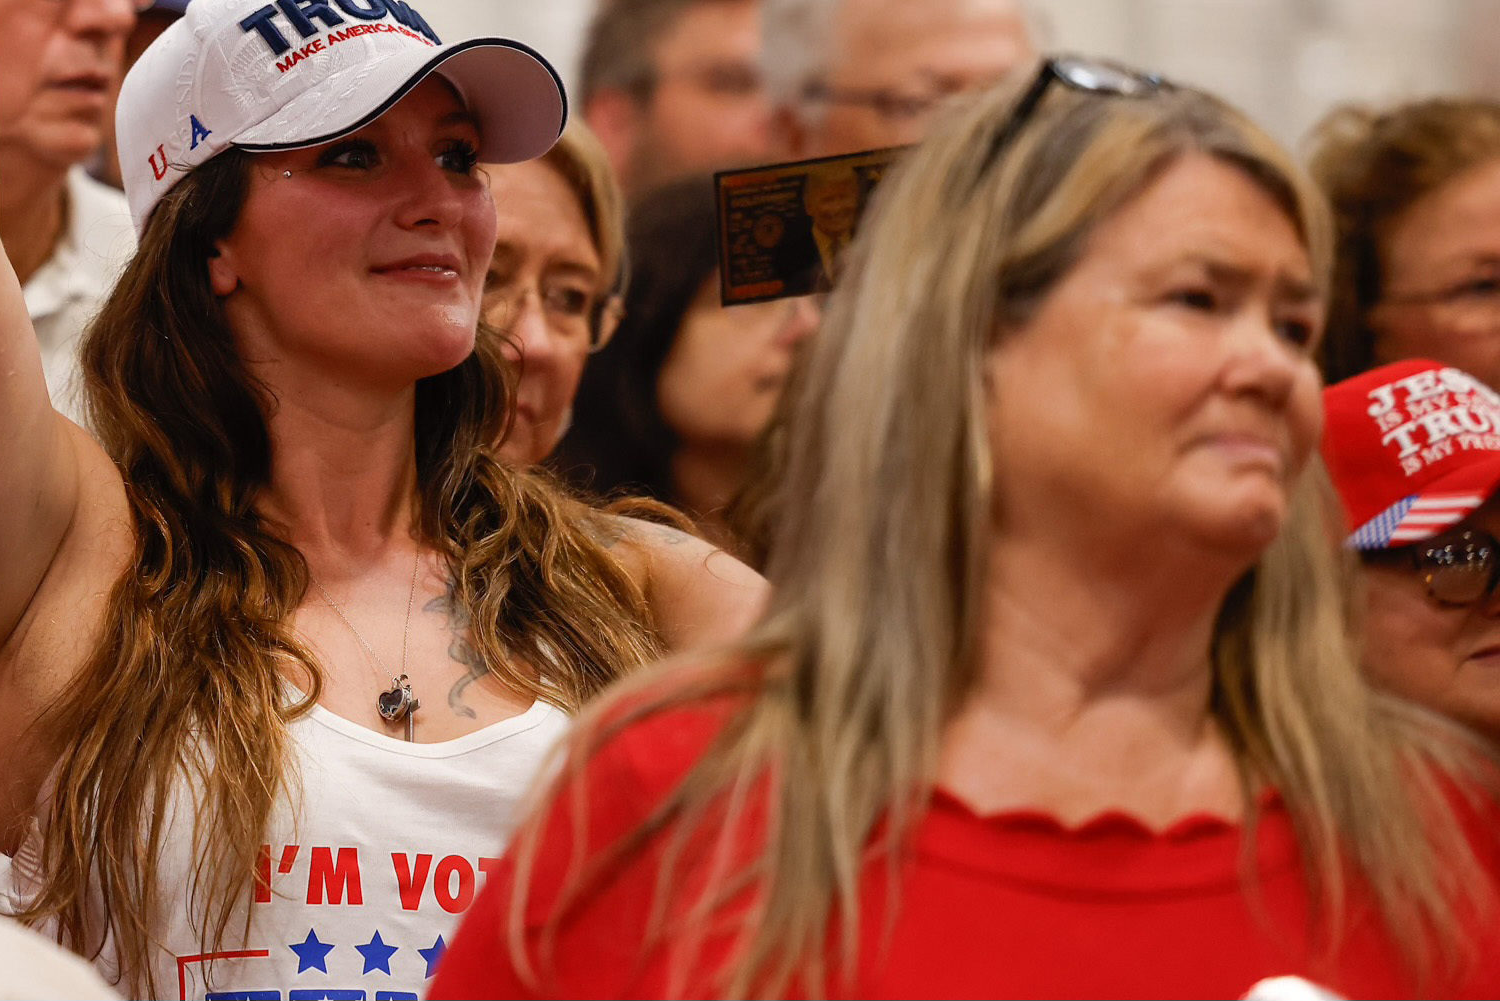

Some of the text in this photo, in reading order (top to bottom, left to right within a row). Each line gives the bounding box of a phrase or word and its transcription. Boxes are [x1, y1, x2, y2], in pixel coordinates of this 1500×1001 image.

[275, 38, 327, 74] MAKE
[326, 23, 399, 47] AMERICA
[254, 844, 363, 905] I'M
